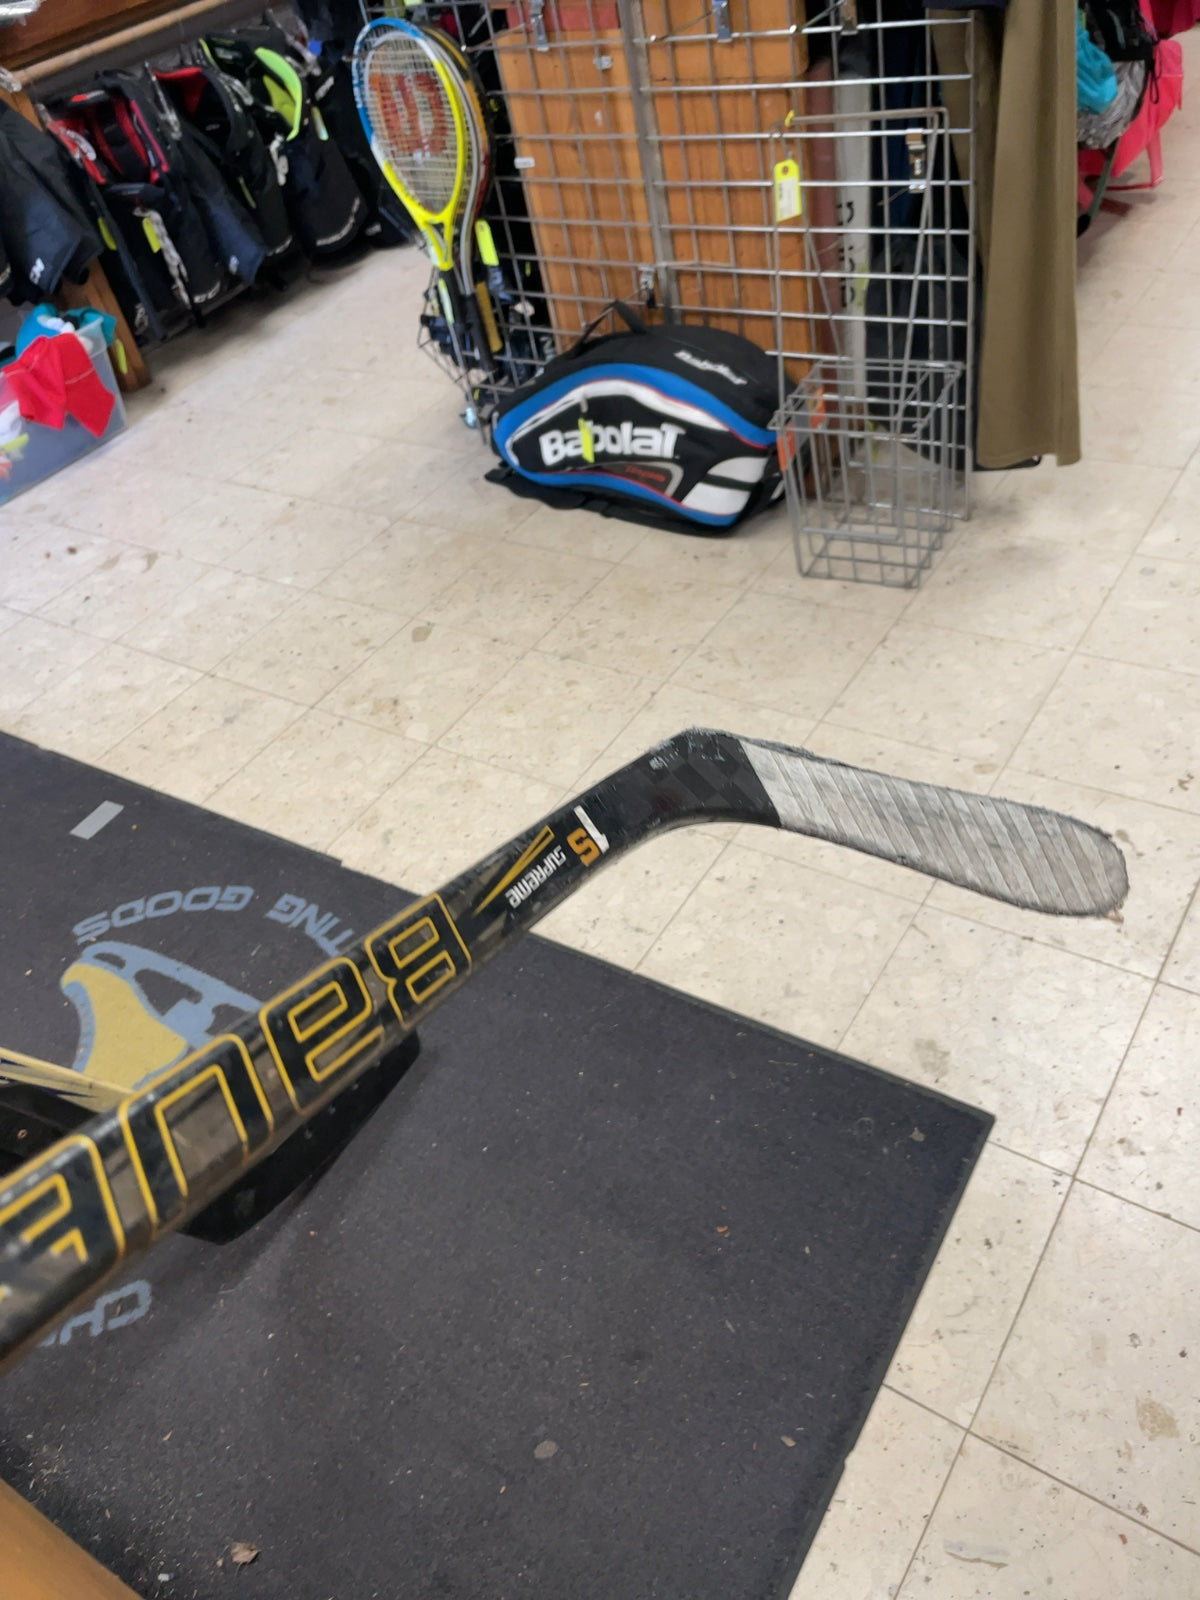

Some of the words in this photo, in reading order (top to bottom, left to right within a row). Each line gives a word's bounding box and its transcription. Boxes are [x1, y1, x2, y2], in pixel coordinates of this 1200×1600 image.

[539, 420, 687, 466] Babolat
[505, 845, 567, 908] SUPREME
[72, 886, 255, 945] GOODS
[265, 893, 354, 957] TING
[0, 892, 472, 1345] BAUE
